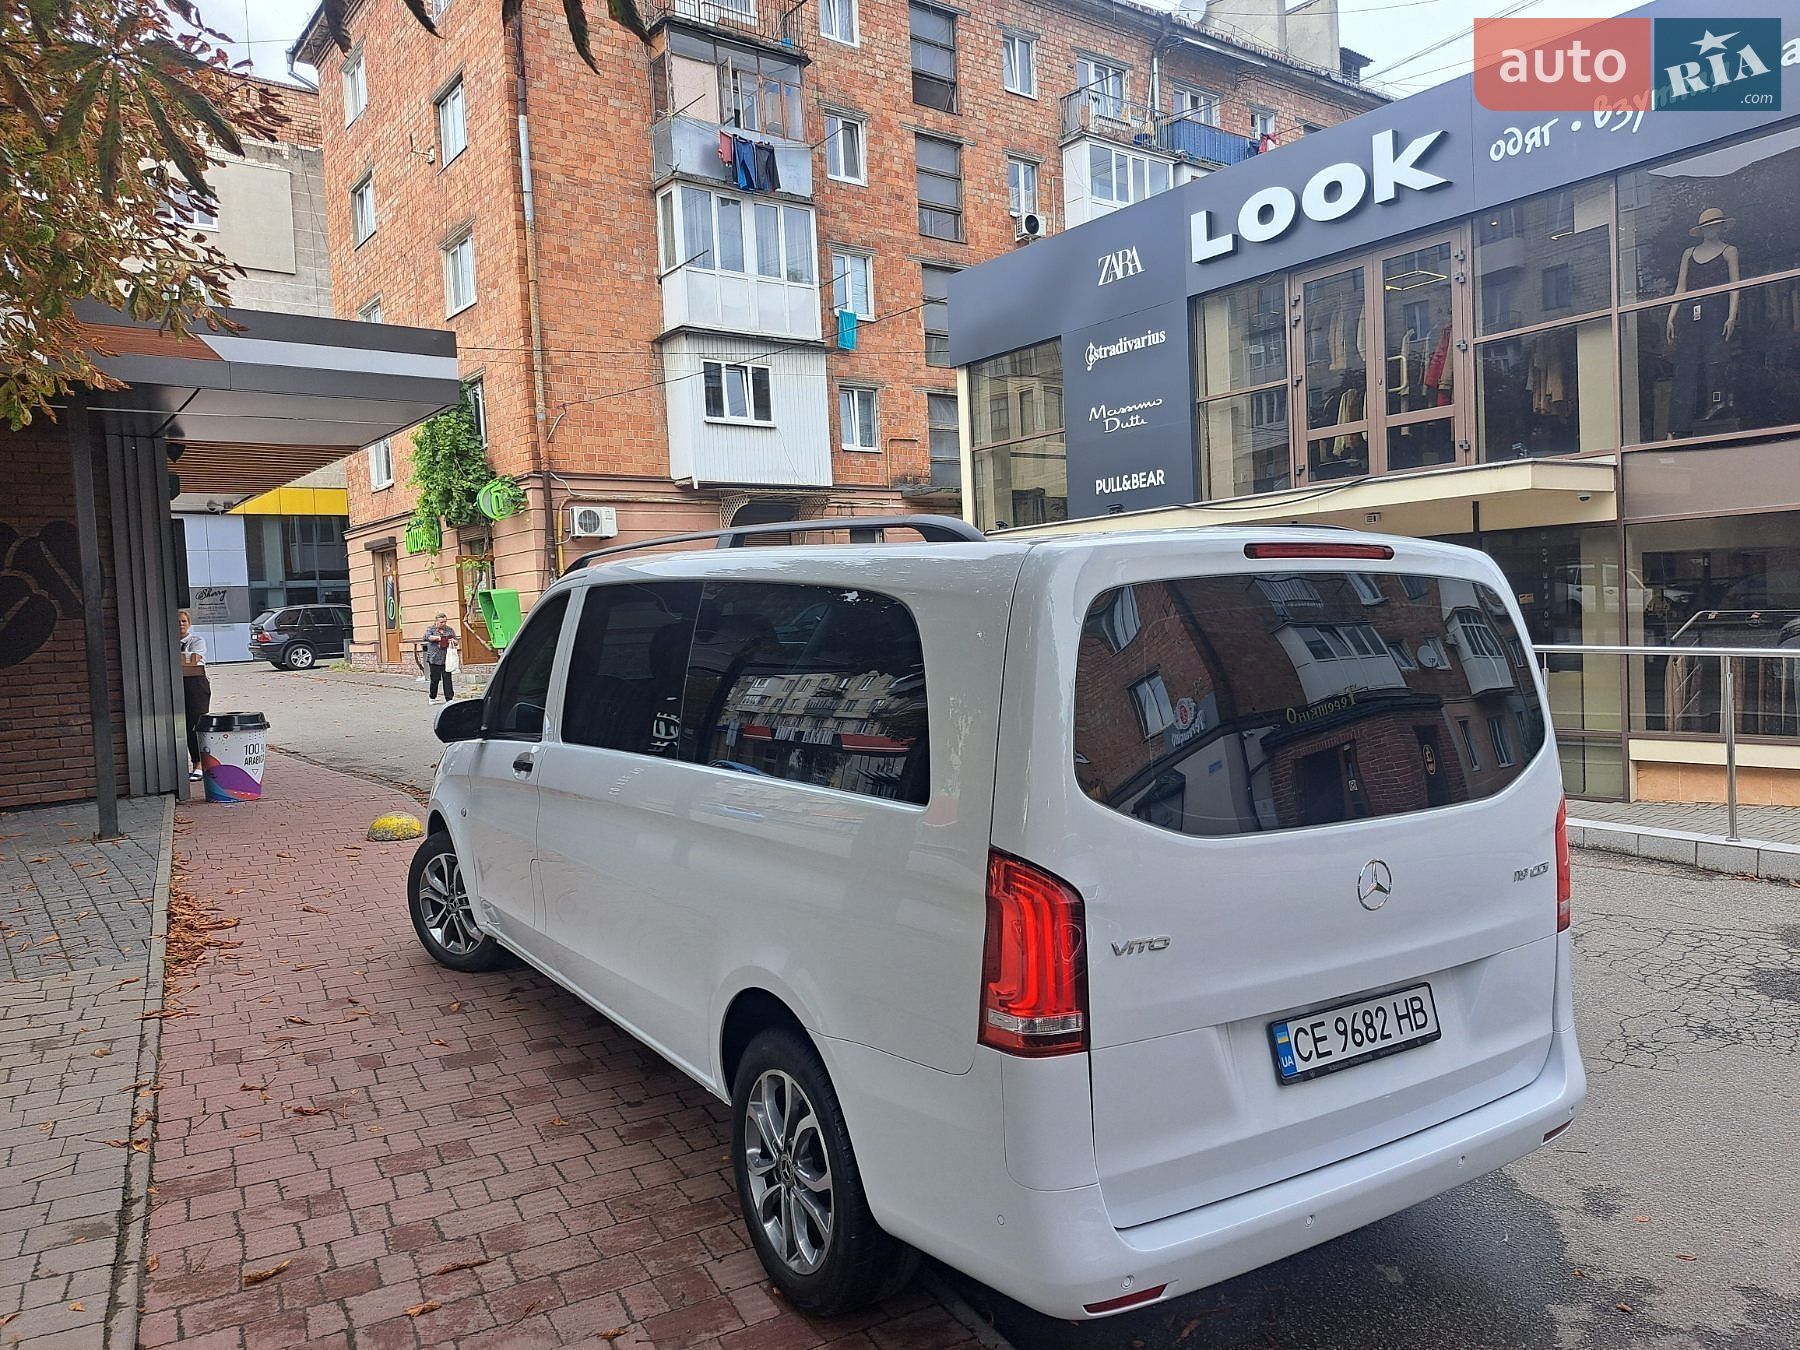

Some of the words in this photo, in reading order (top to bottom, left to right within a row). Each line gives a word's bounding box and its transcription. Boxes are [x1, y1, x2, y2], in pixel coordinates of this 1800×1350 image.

[1489, 117, 1559, 162] одяг
[1190, 127, 1453, 264] LOOK
[1097, 244, 1145, 287] ZARA
[1088, 398, 1163, 422] Massimo
[1102, 414, 1149, 433] Dutti
[1095, 469, 1166, 495] PULL&BEAR
[244, 743, 260, 756] 100
[1111, 937, 1171, 957] VITO
[1294, 1020, 1333, 1063] CE
[1334, 1005, 1393, 1054] 9682
[1393, 995, 1429, 1036] HB
[1281, 1056, 1295, 1068] UA
